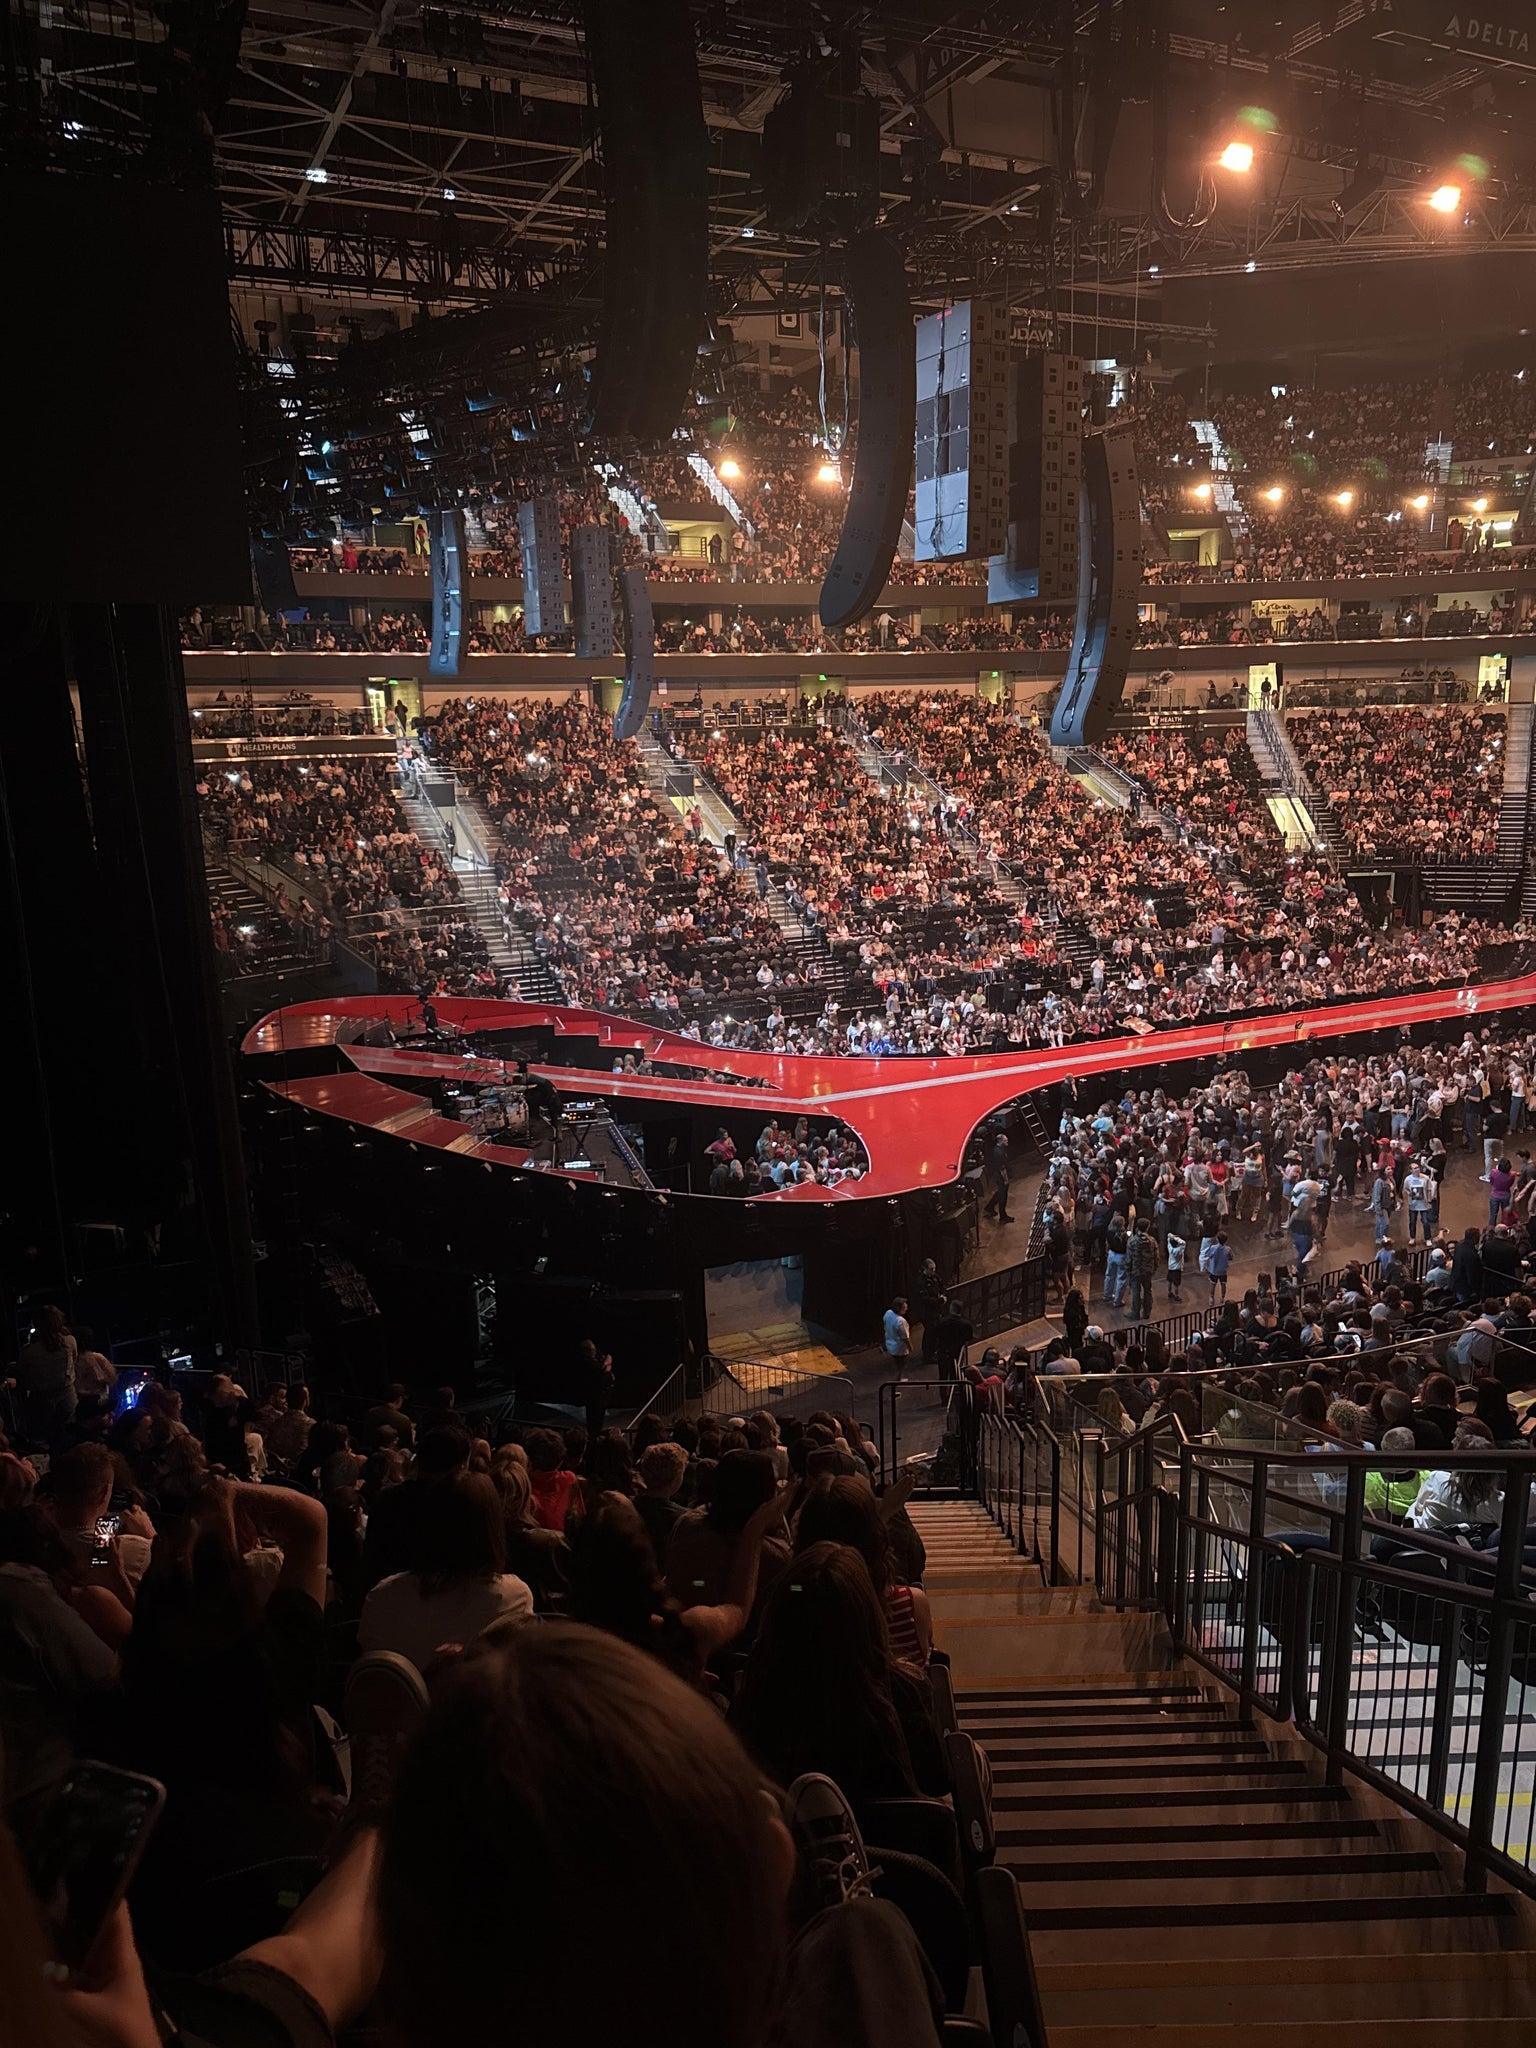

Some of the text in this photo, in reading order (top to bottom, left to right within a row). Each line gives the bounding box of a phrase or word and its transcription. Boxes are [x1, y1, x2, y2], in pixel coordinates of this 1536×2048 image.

[1466, 19, 1529, 53] DELTA
[242, 743, 271, 752] HEALTH
[272, 742, 297, 751] PLANS
